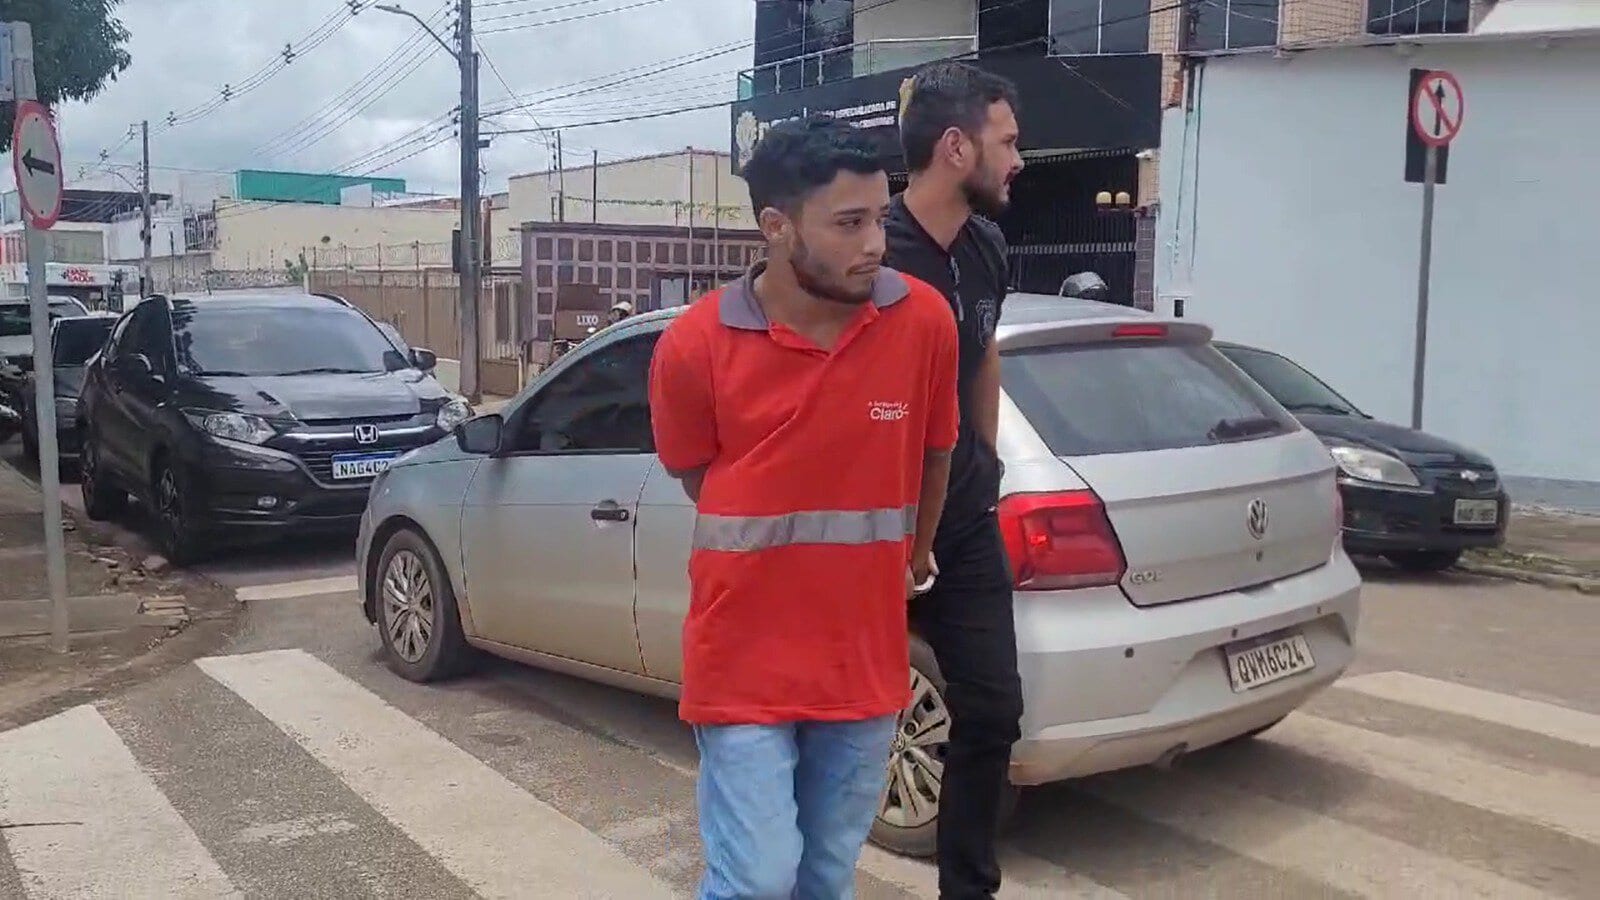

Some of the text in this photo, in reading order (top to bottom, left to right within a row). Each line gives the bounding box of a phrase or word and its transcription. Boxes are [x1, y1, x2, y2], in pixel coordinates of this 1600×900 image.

[576, 314, 599, 326] LIXO
[870, 407, 904, 421] Claro
[340, 461, 389, 475] NAG4C2
[1237, 640, 1306, 683] QWM6C24
